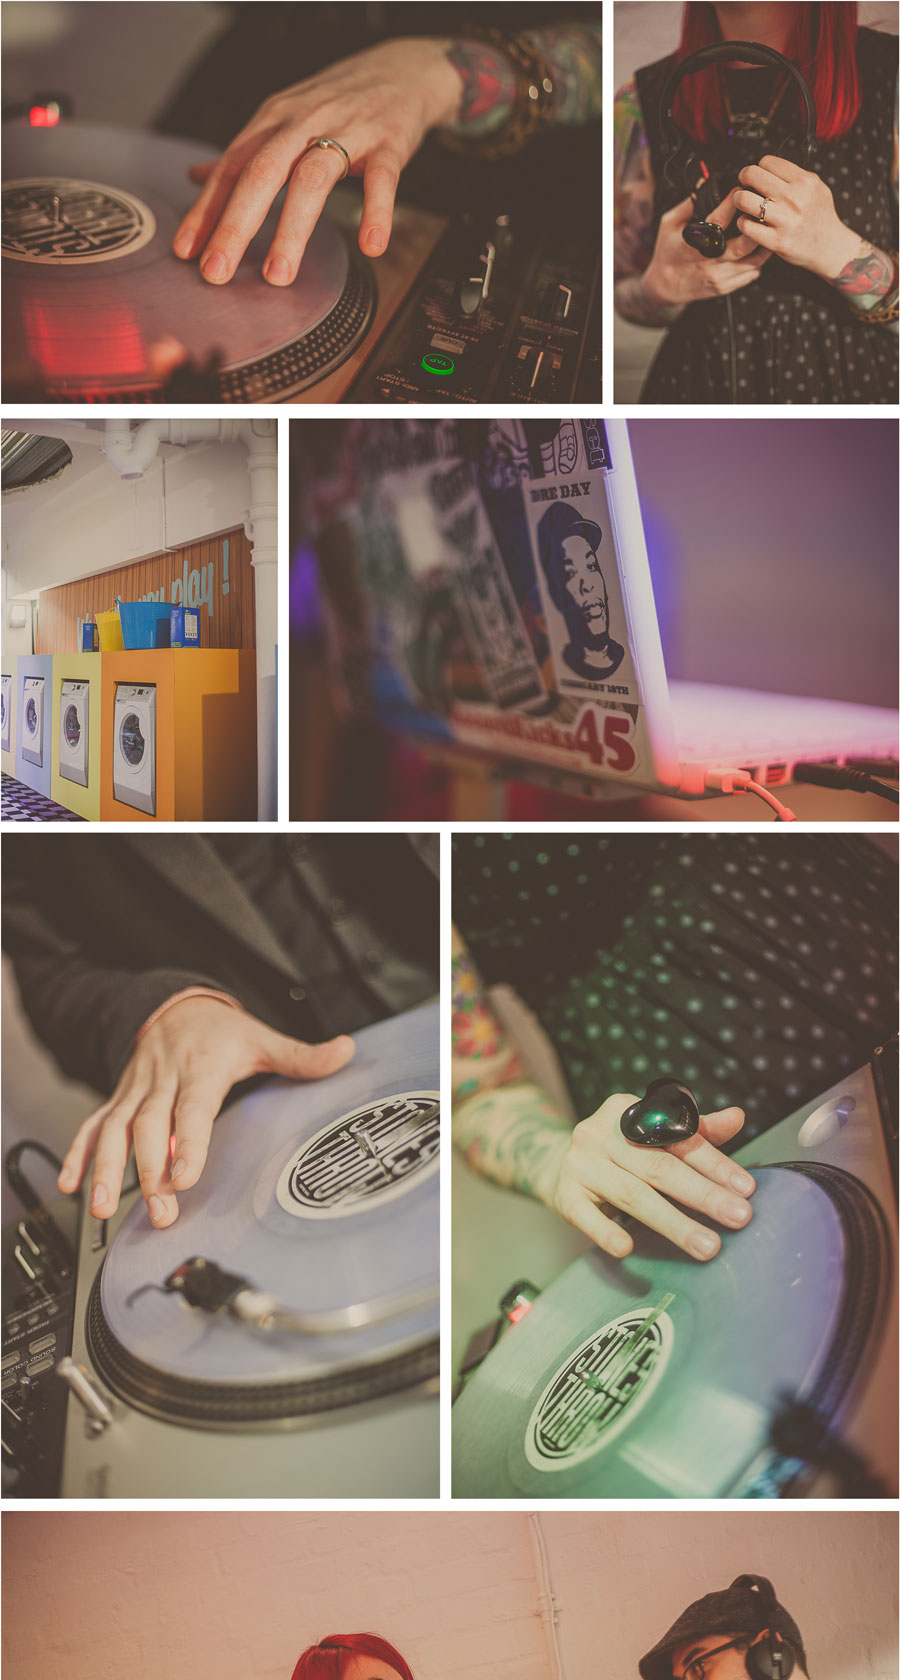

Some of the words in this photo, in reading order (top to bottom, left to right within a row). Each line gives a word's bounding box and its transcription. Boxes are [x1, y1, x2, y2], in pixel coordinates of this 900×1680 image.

[429, 357, 448, 367] TAP
[530, 486, 558, 502] DRE
[559, 481, 591, 499] DAY
[31, 1346, 57, 1362] SOUND
[4, 1360, 30, 1376] COLOR
